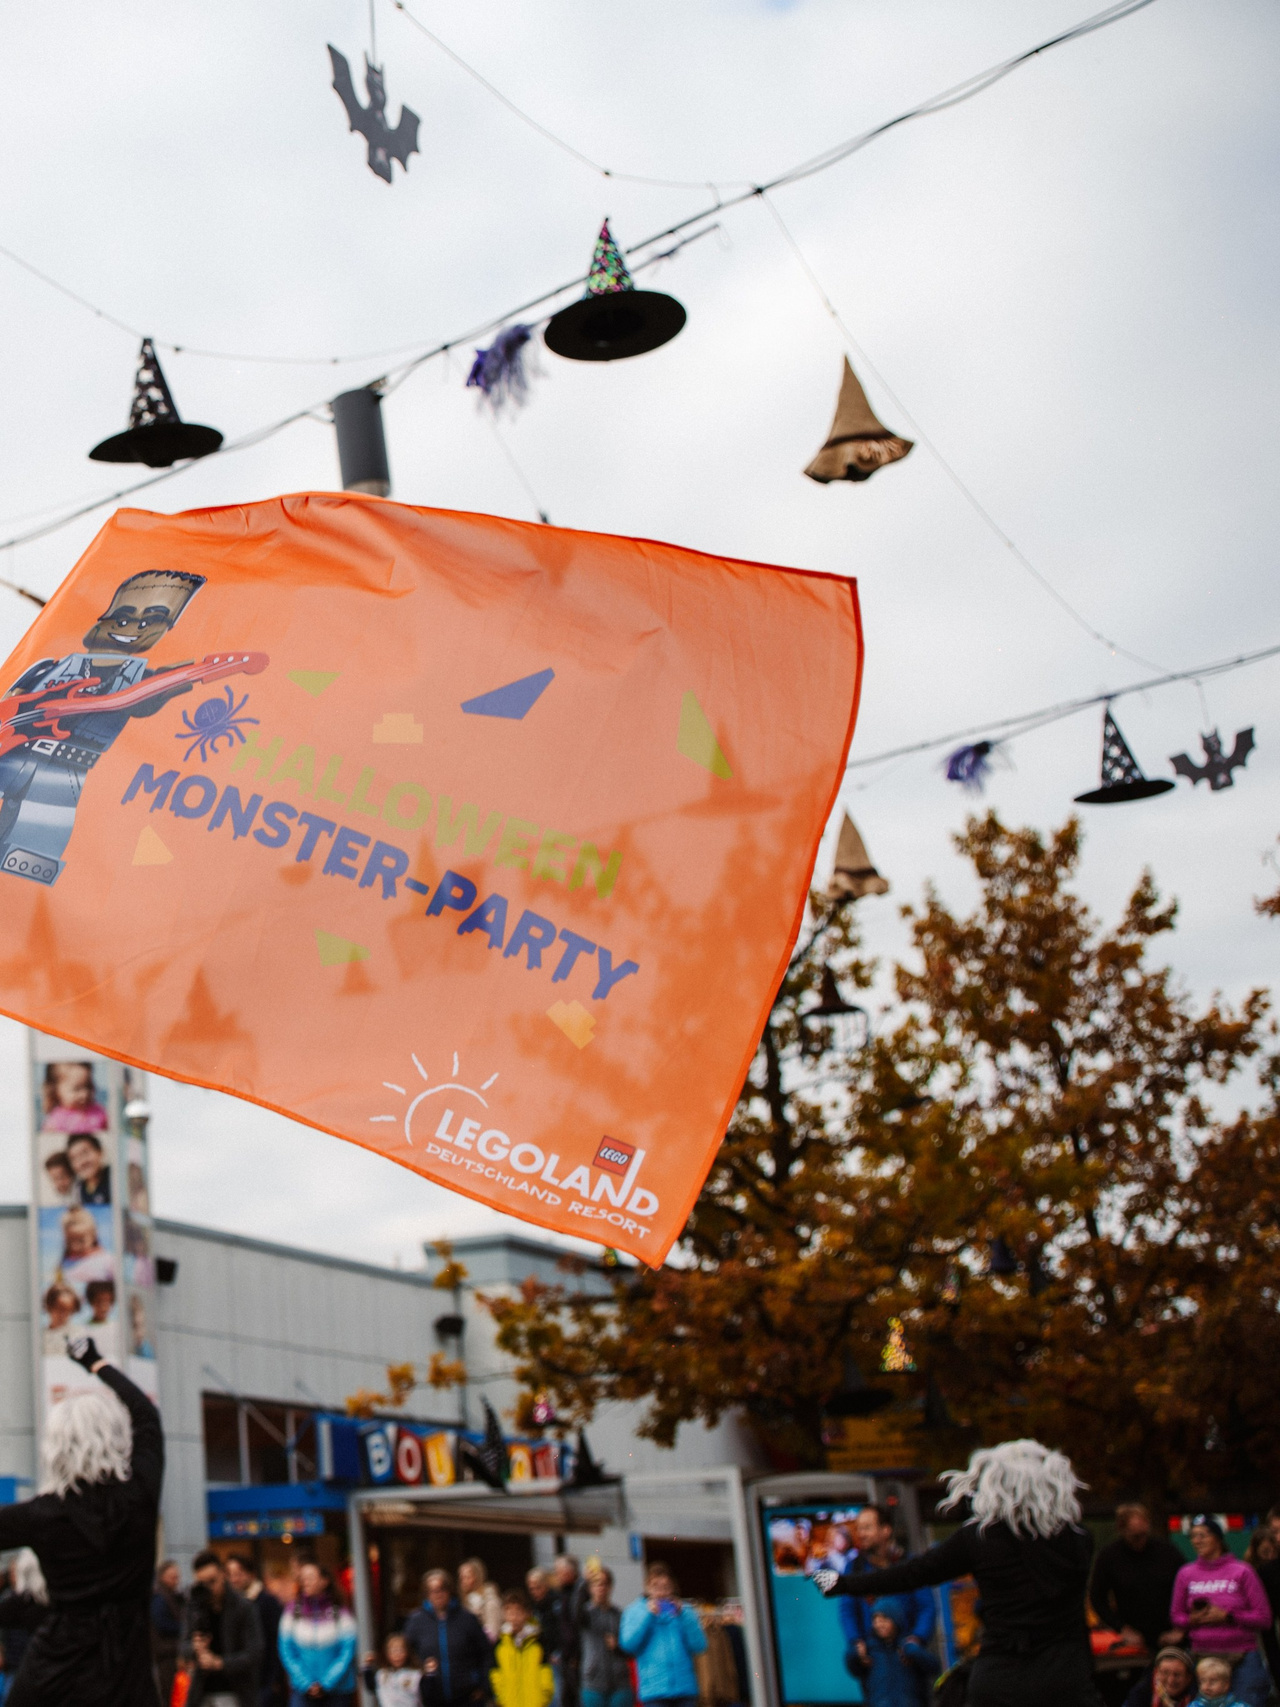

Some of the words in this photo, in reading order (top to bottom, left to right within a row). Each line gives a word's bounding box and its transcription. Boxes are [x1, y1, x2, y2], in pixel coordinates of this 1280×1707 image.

[231, 730, 623, 900] HALLOWEEN
[121, 763, 640, 1000] MONSTER-PARTY
[425, 1142, 562, 1206] DEUTSCHLAND
[568, 1201, 651, 1238] RESORT
[435, 1109, 659, 1217] LEGOLAND
[599, 1146, 629, 1165] LEGO
